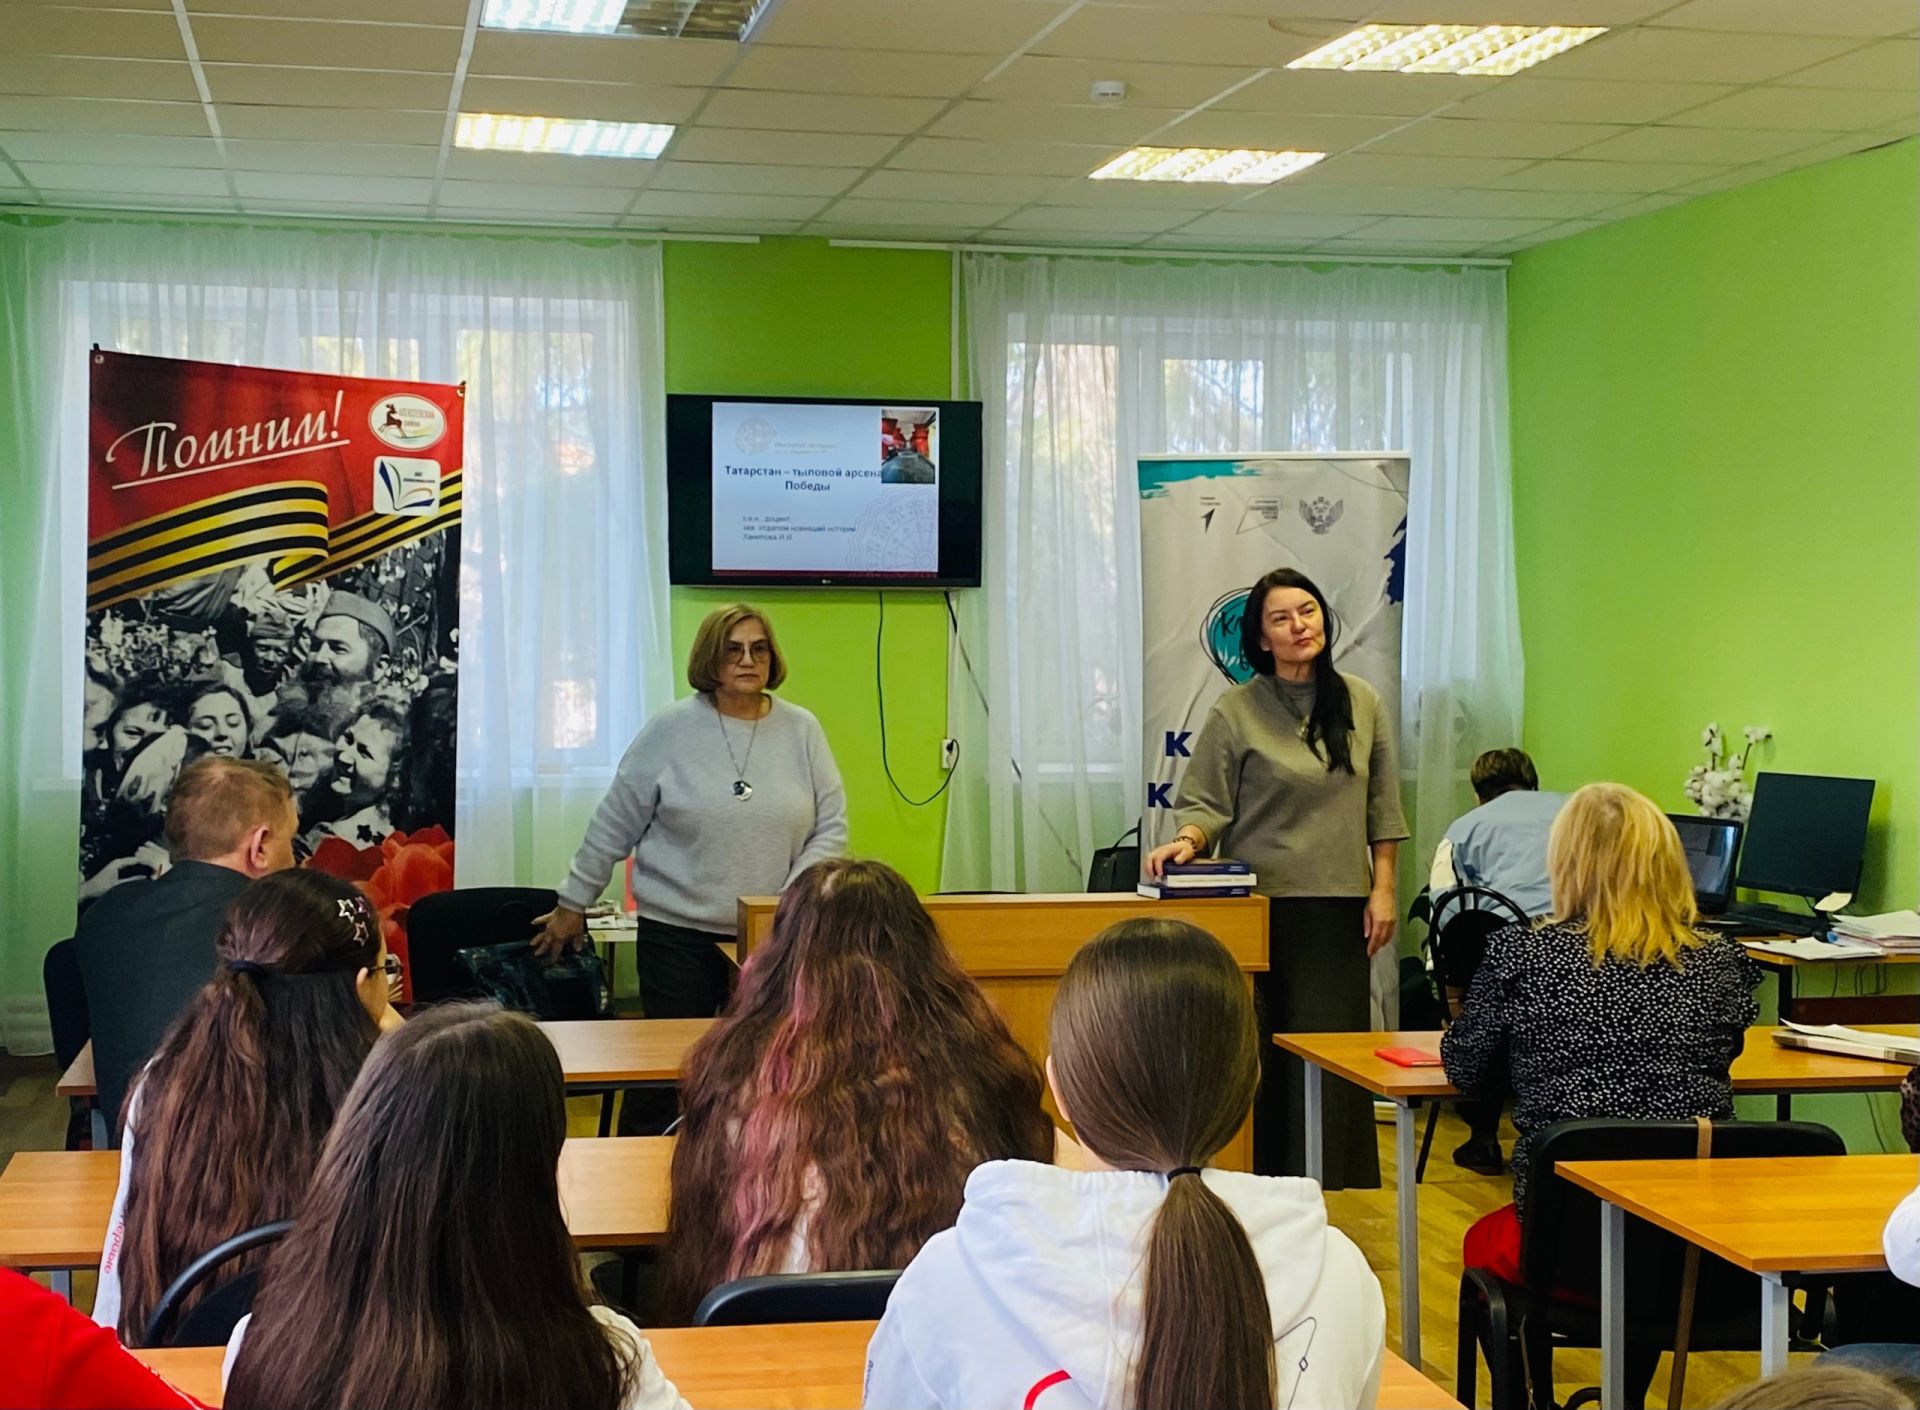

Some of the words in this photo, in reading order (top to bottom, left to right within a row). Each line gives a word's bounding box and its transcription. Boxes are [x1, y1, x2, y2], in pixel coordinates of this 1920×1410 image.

[105, 389, 344, 477] Помним!
[725, 465, 781, 477] Татарстан
[793, 467, 842, 478] тыловой
[785, 480, 830, 492] Победы
